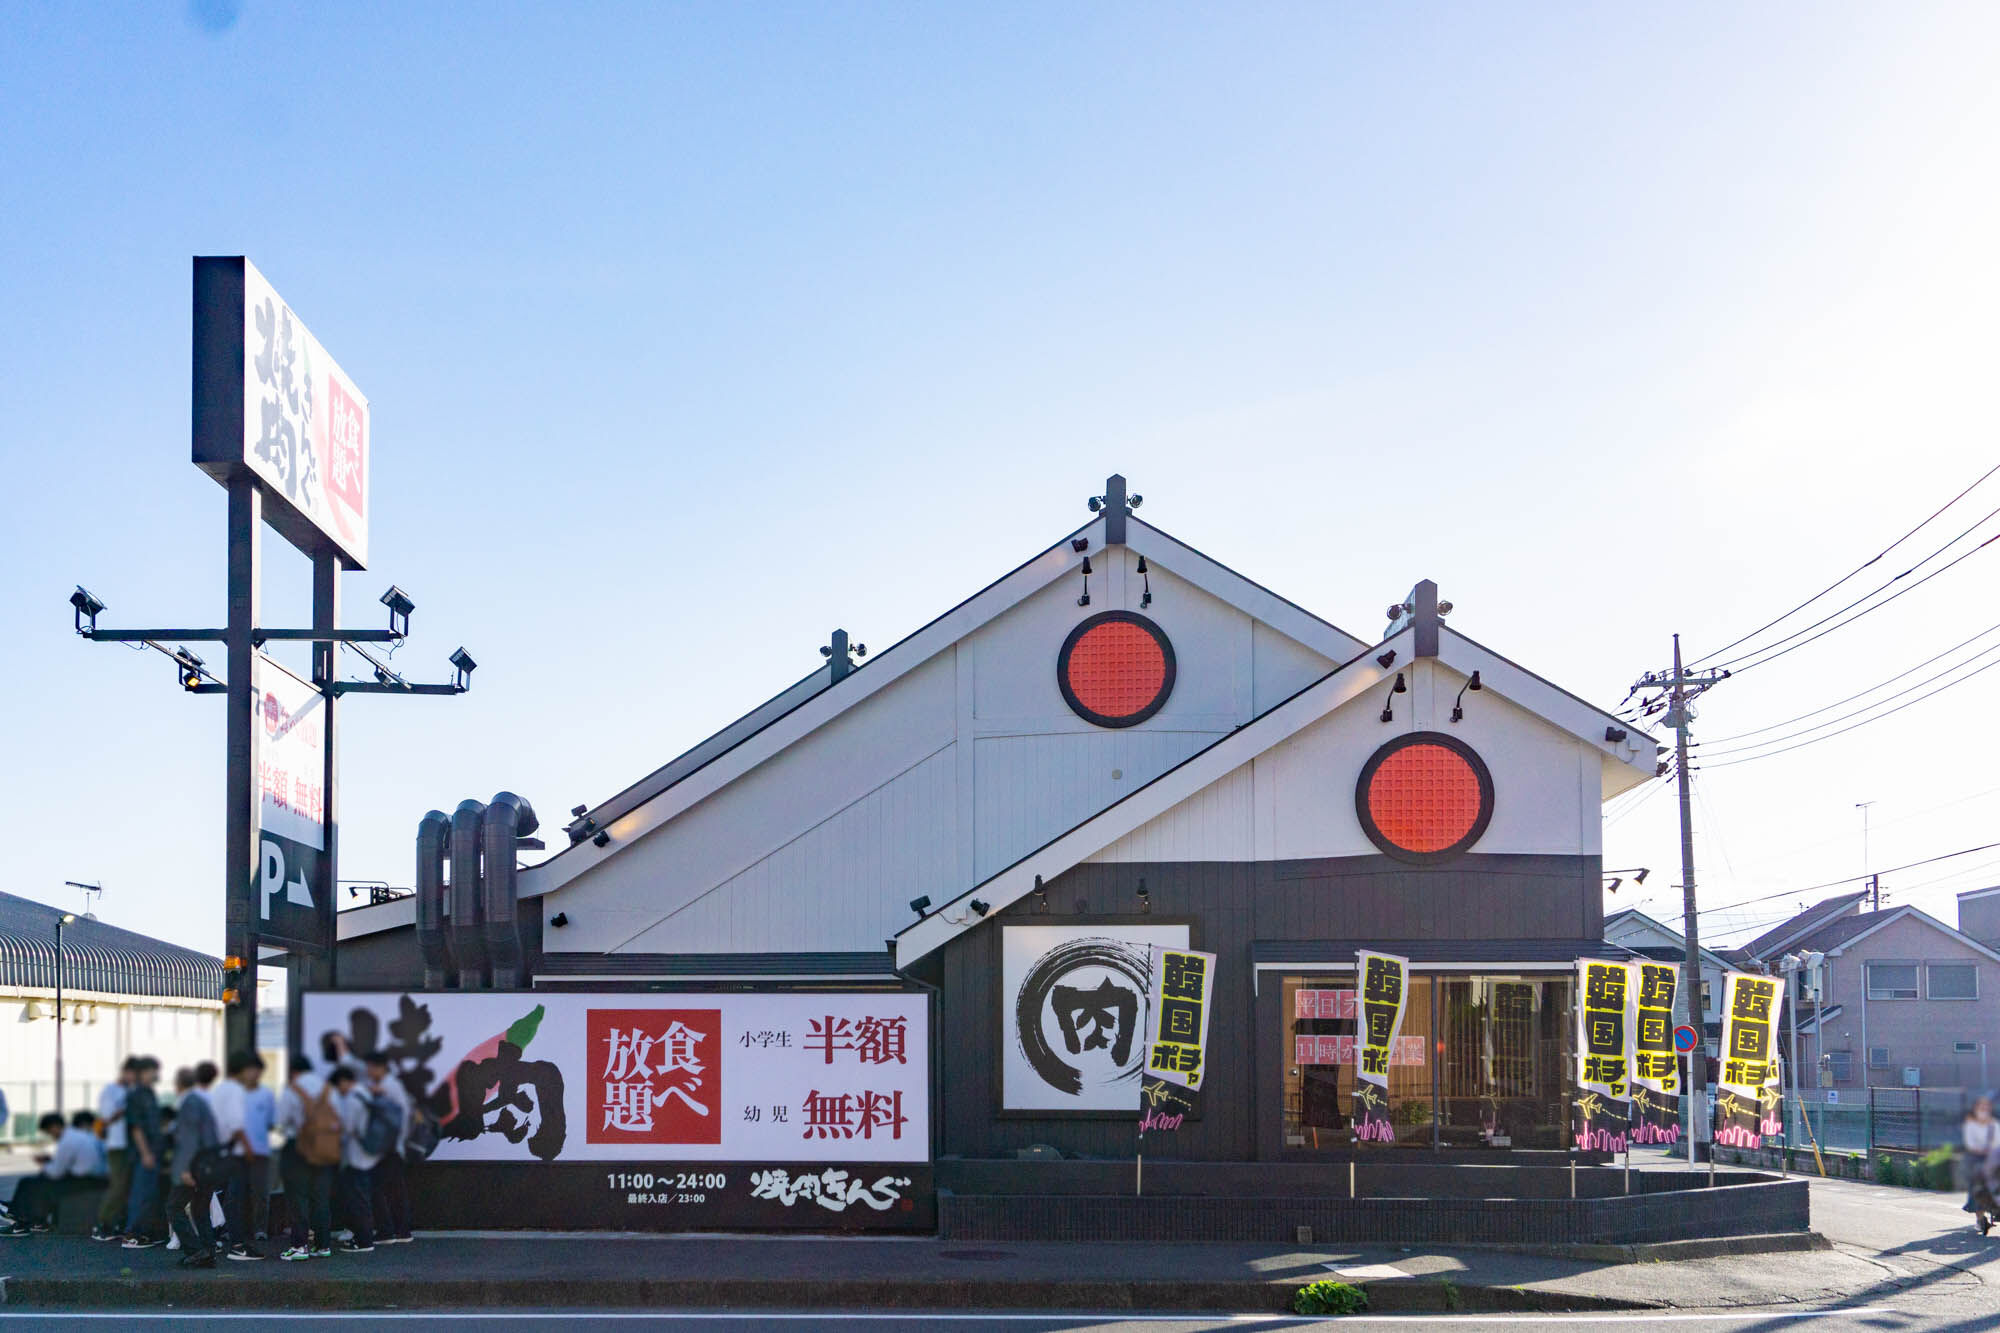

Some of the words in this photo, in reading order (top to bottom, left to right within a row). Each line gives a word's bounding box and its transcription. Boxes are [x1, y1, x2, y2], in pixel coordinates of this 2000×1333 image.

[294, 776, 322, 825] 無料
[261, 840, 285, 920] P
[1297, 997, 1357, 1016] 平日ラ
[1362, 955, 1402, 1076] 韓国ポ
[738, 1030, 793, 1049] 小学生
[802, 1015, 908, 1065] 半額
[601, 1027, 655, 1133] 放題
[652, 1020, 710, 1118] 食べ
[802, 1089, 909, 1140] 無料
[750, 1167, 911, 1212] 焼肉きんぐ
